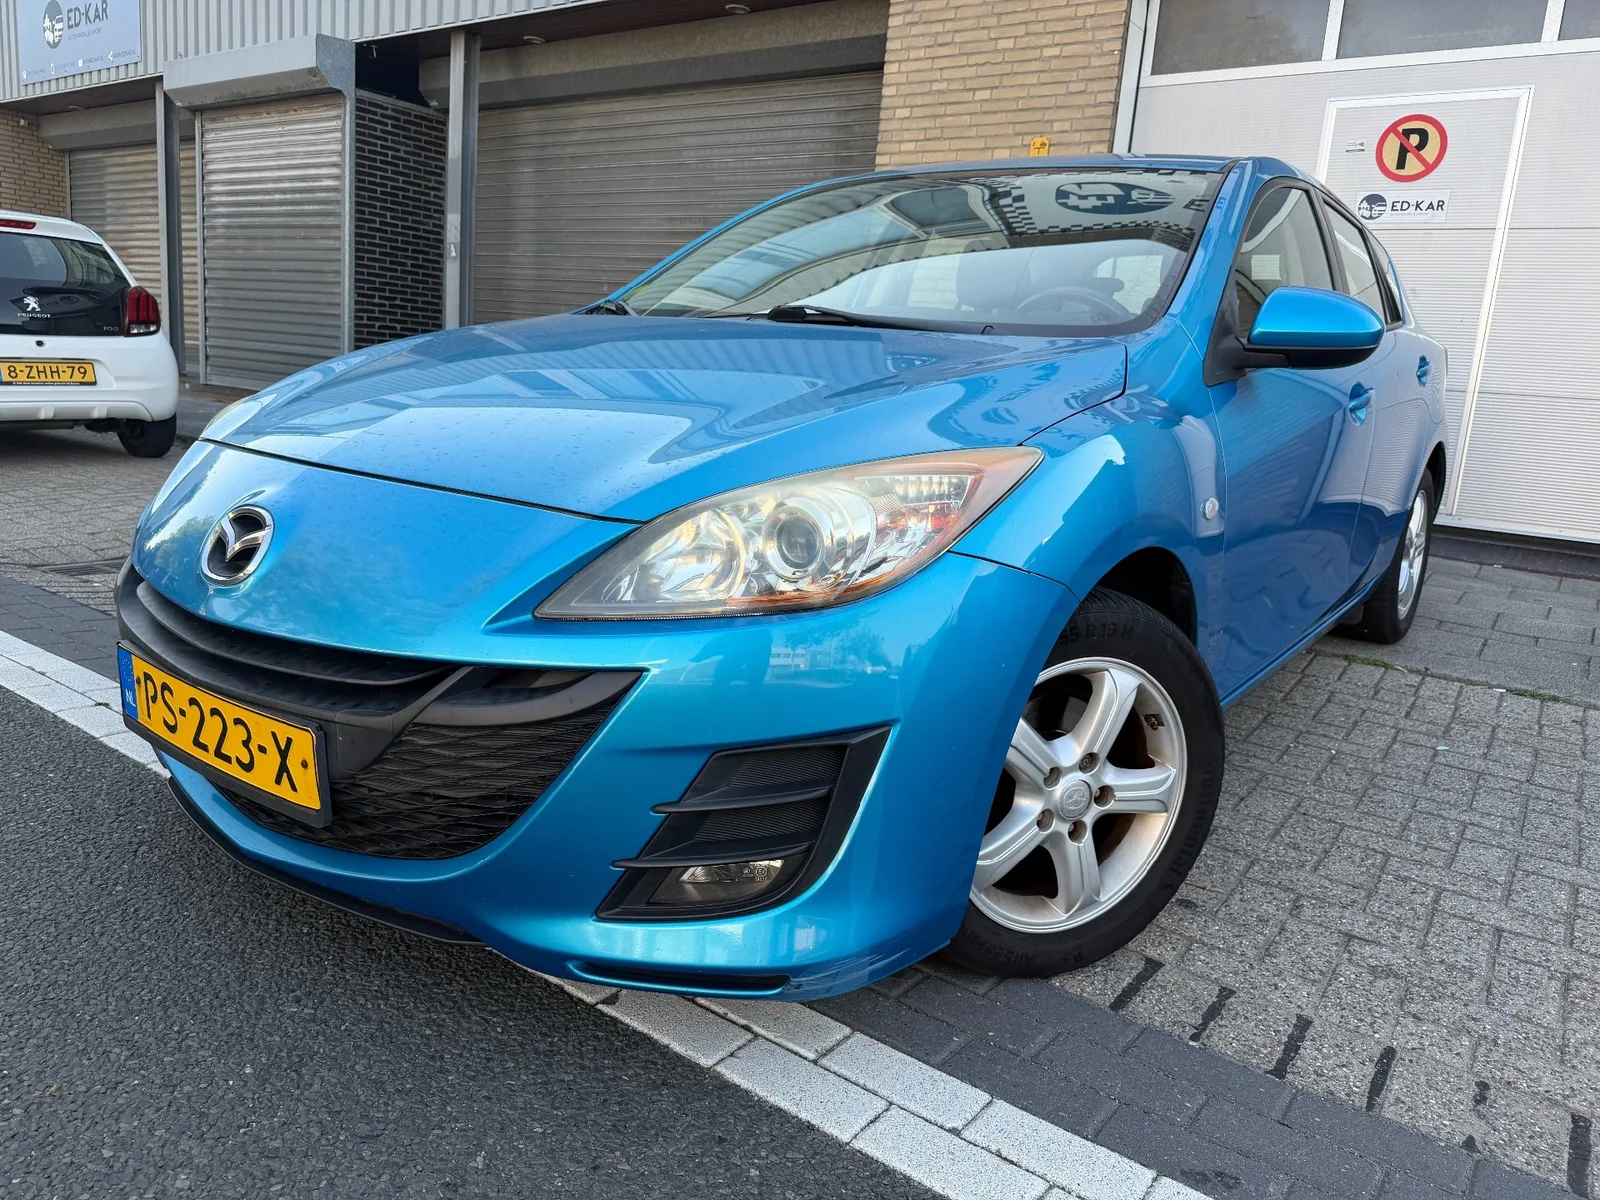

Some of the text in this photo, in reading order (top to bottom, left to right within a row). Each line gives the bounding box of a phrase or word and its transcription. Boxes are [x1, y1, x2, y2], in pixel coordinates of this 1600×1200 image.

[67, 0, 108, 29] ED-KAR
[1396, 128, 1429, 170] P
[1390, 199, 1445, 213] ED-KAR
[7, 365, 87, 379] 8-ZHH-79
[125, 688, 136, 707] NL
[143, 671, 298, 793] PS-223-X
